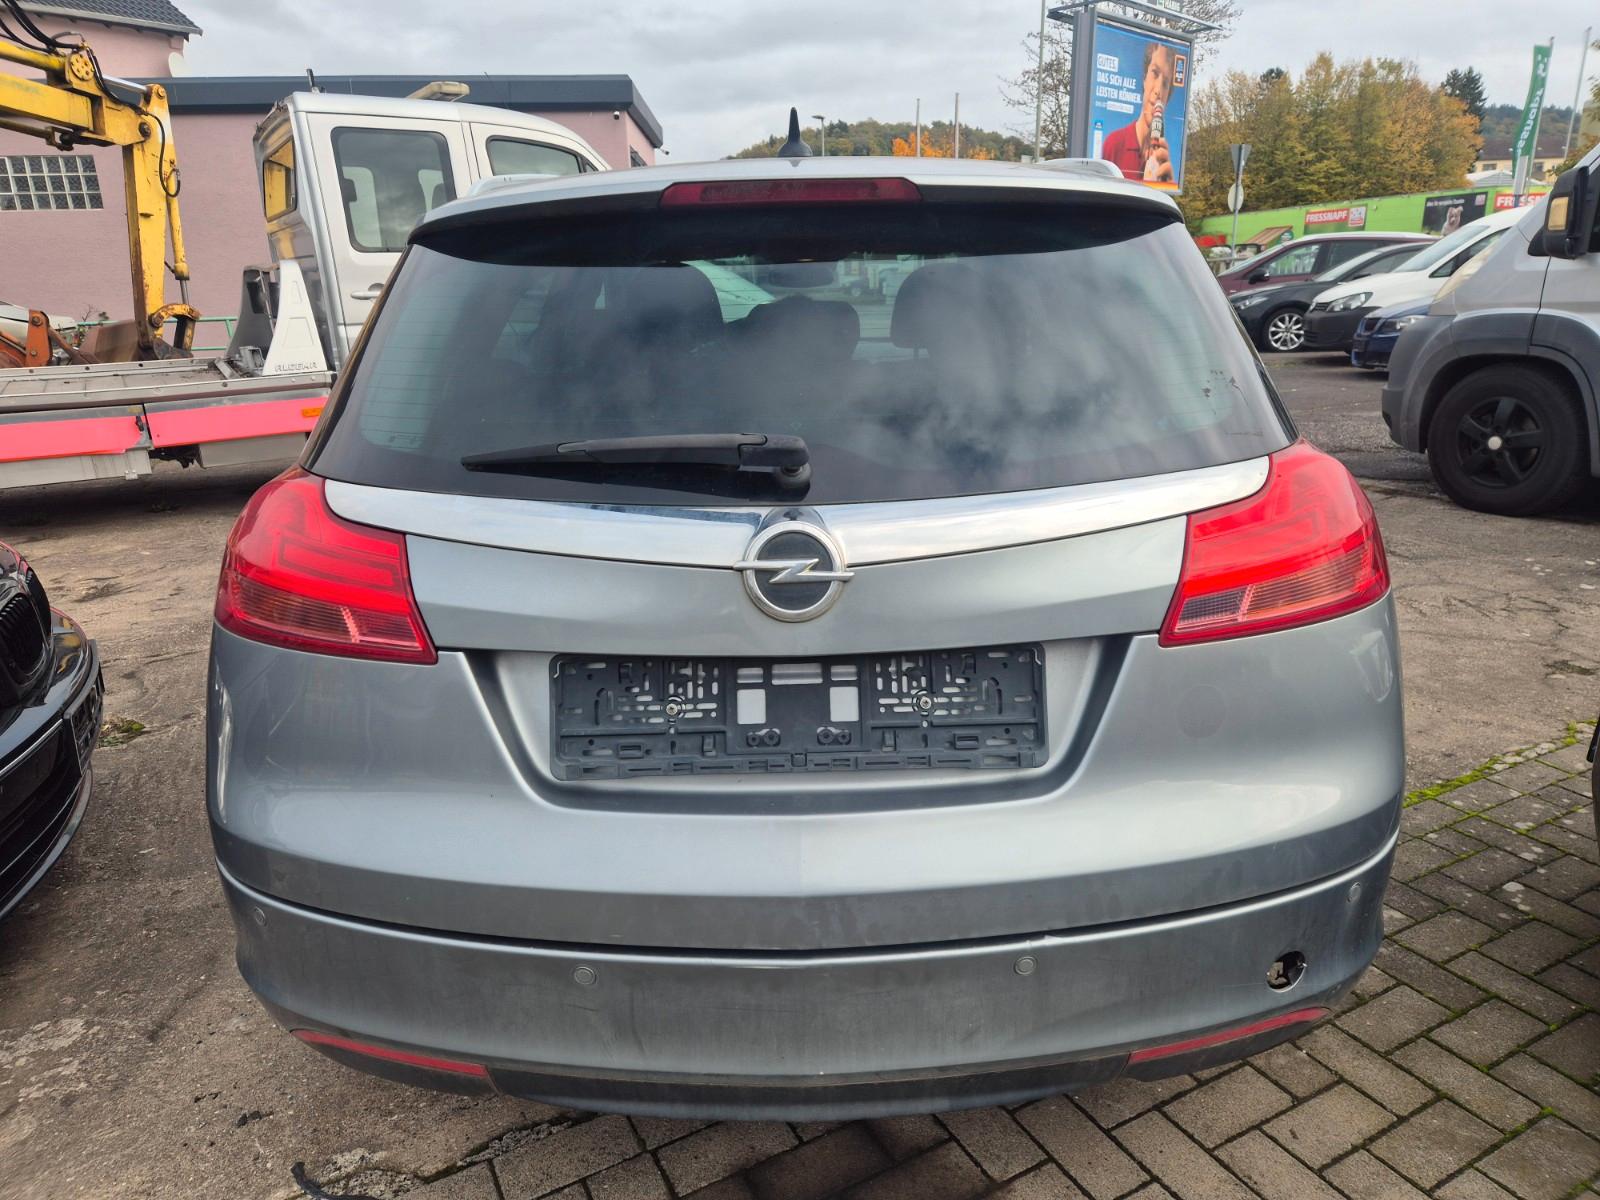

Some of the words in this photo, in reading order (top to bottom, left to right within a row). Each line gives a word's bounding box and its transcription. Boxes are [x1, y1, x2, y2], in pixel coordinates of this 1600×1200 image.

[1097, 71, 1109, 84] DAS
[1110, 74, 1122, 87] SICH
[1122, 76, 1136, 89] ALLE
[1096, 85, 1118, 99] LEISTEN
[1306, 210, 1348, 223] FRESSNAPF
